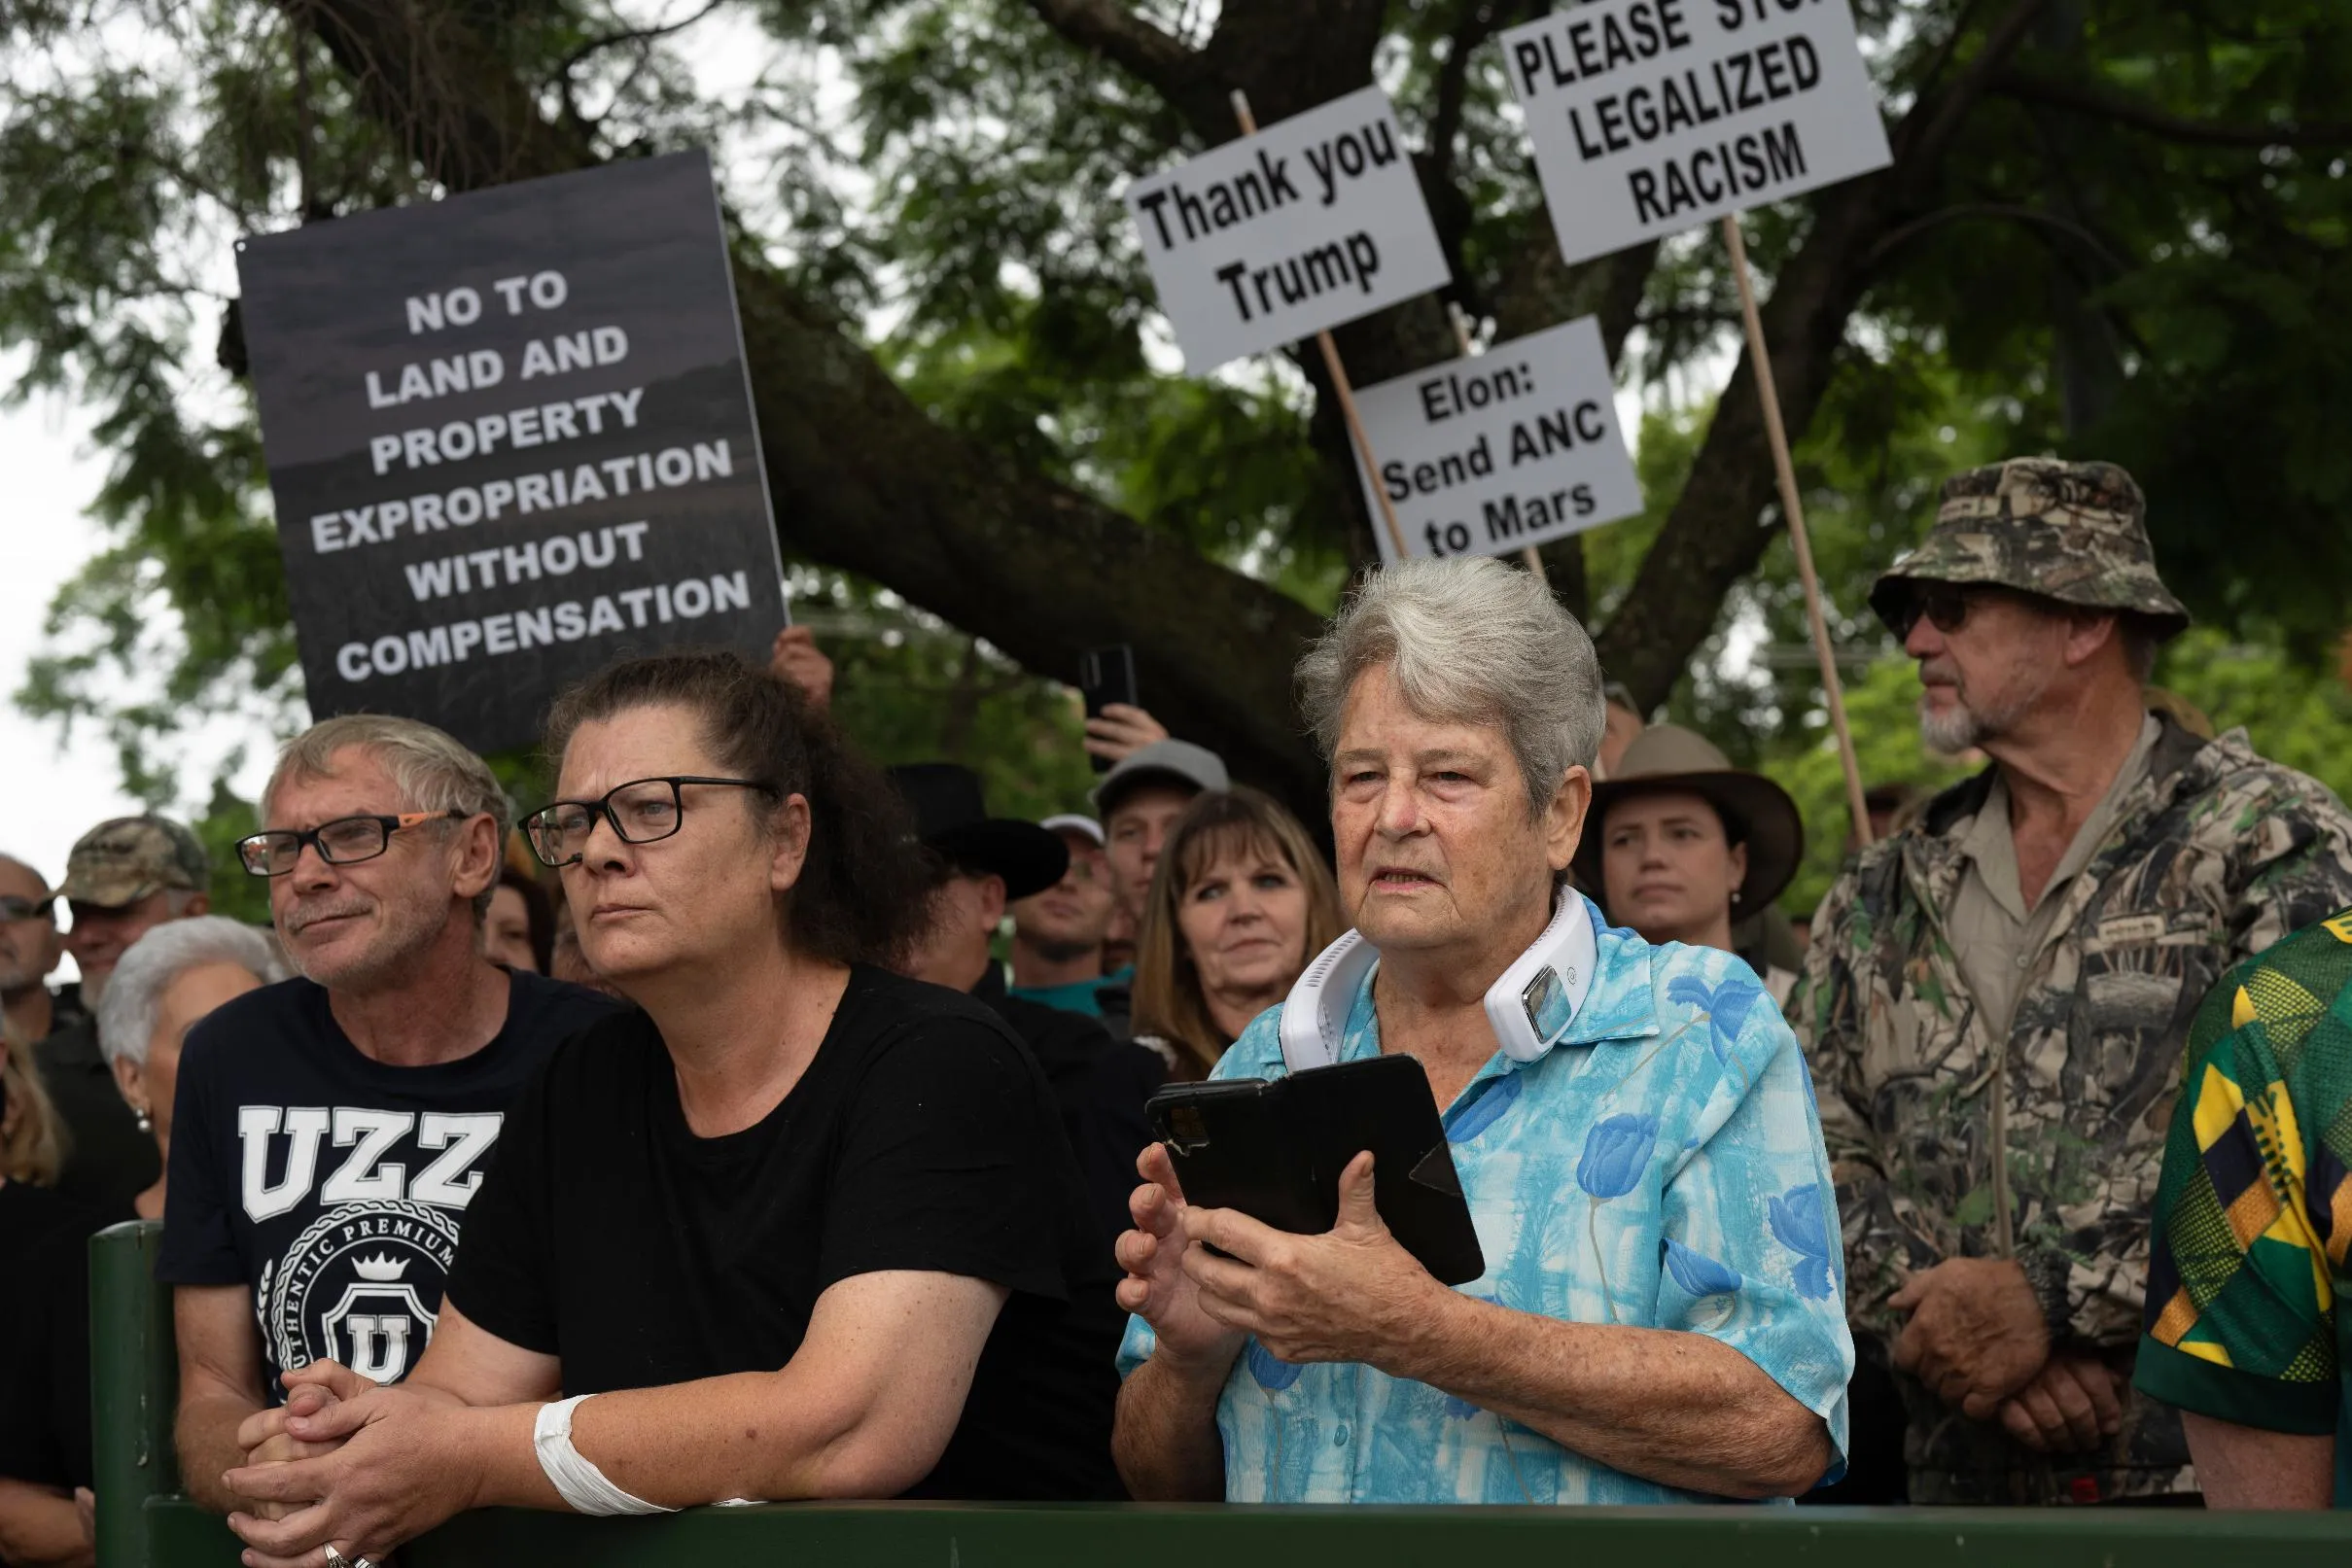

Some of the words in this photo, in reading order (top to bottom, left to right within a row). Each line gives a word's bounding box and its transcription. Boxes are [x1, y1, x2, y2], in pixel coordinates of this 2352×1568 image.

[1512, 0, 1693, 97] PLEASE
[1567, 33, 1821, 162] LEGALIZED
[1136, 148, 1301, 251] Thank
[1303, 119, 1399, 208] you
[1627, 121, 1808, 226] RACISM
[404, 286, 483, 335] NO
[493, 269, 569, 316] TO
[1214, 229, 1381, 324] Trump
[365, 349, 506, 410] LAND
[519, 325, 630, 381] AND
[1417, 361, 1535, 425] Elon:
[369, 386, 644, 476] PROPERTY
[1382, 434, 1495, 505] Send
[1509, 400, 1606, 468] ANC
[309, 437, 735, 554] EXPROPRIATION
[1422, 518, 1472, 561] to
[1481, 483, 1597, 542] Mars
[404, 520, 649, 602] WITHOUT
[335, 570, 752, 682] COMPENSATION
[285, 1237, 335, 1370] UTHENTIC
[342, 1217, 455, 1268] PREMIUM
[345, 1313, 411, 1387] U
